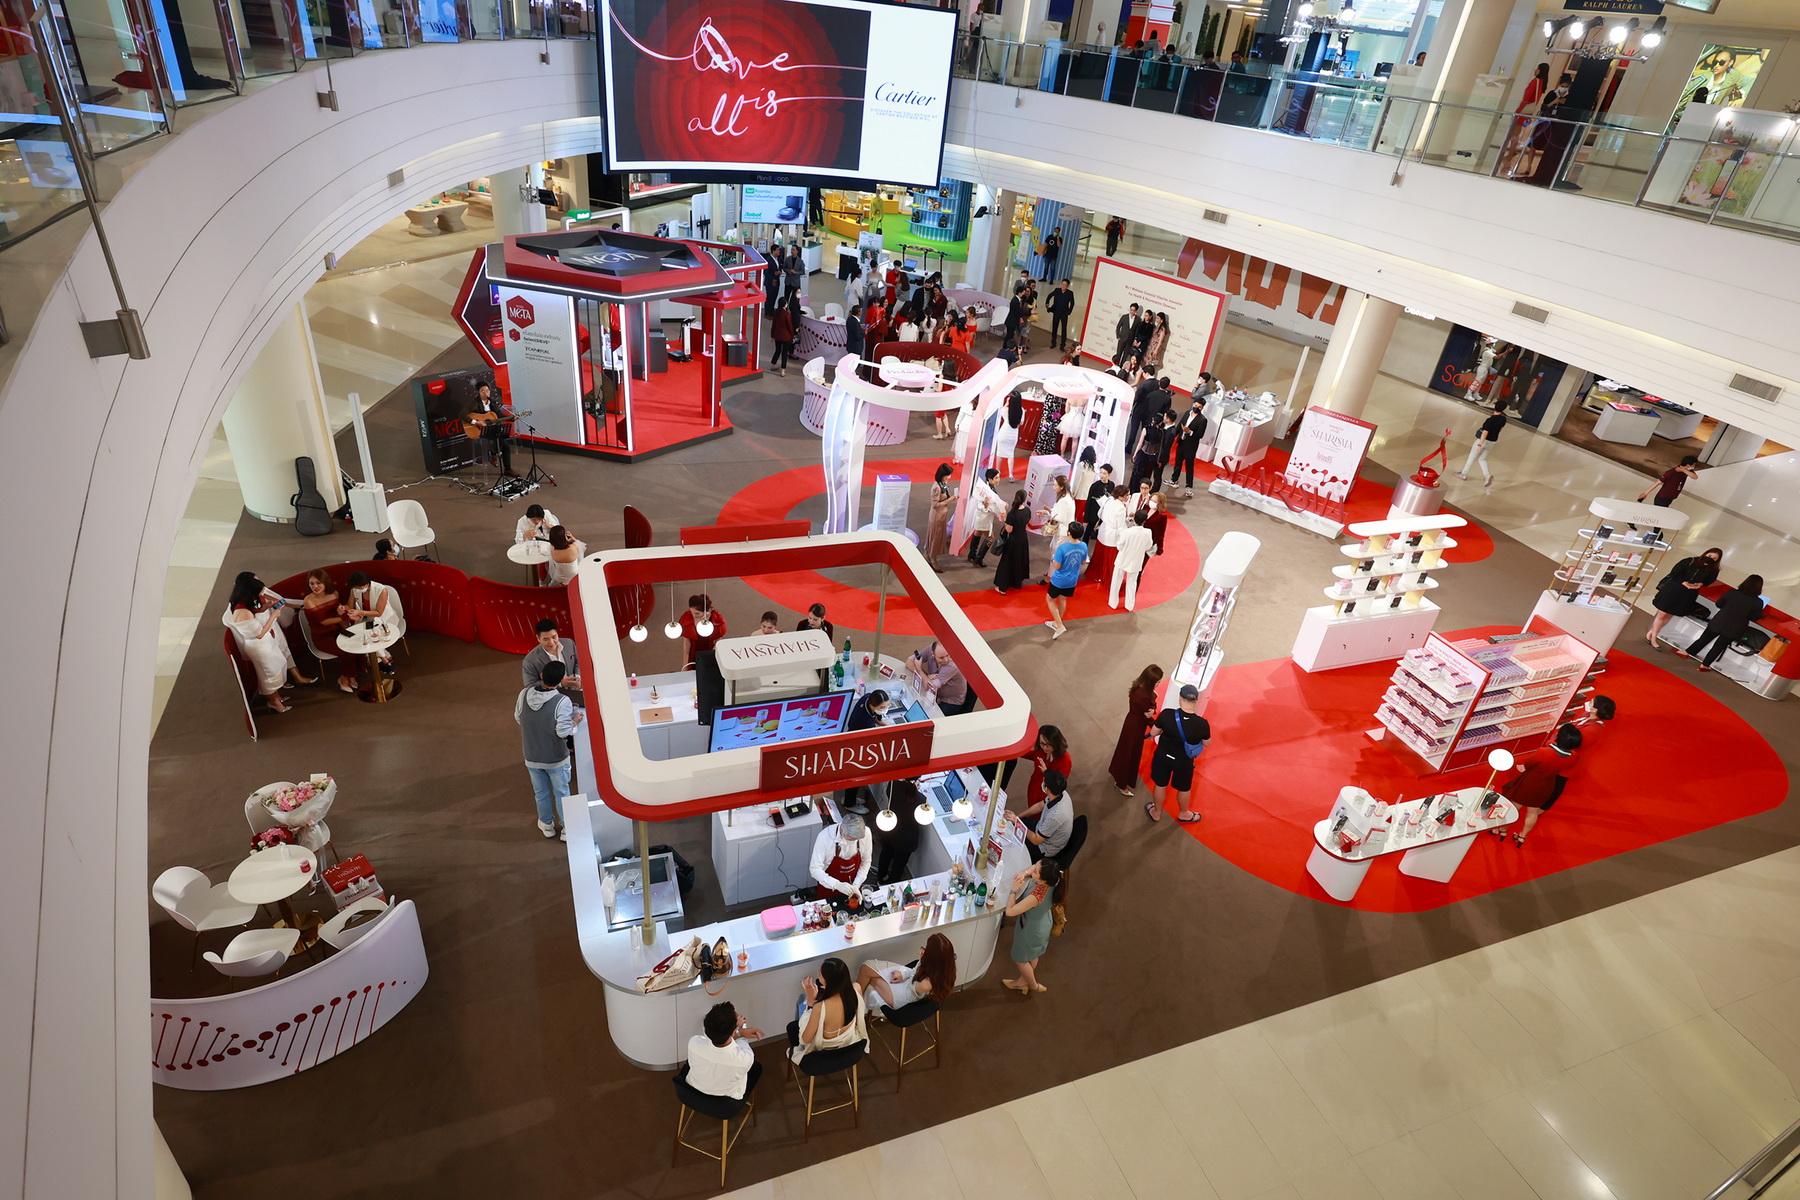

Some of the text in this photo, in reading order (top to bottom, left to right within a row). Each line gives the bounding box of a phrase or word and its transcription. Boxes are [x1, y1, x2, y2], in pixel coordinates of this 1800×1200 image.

[1612, 2, 1644, 10] LAUREN
[875, 81, 936, 106] Cartier
[1441, 364, 1481, 391] Sale
[1311, 429, 1353, 450] SHARISMA
[1216, 455, 1344, 524] SHARISMA
[731, 639, 821, 660] SHARISMA
[784, 738, 911, 779] SHARISMA
